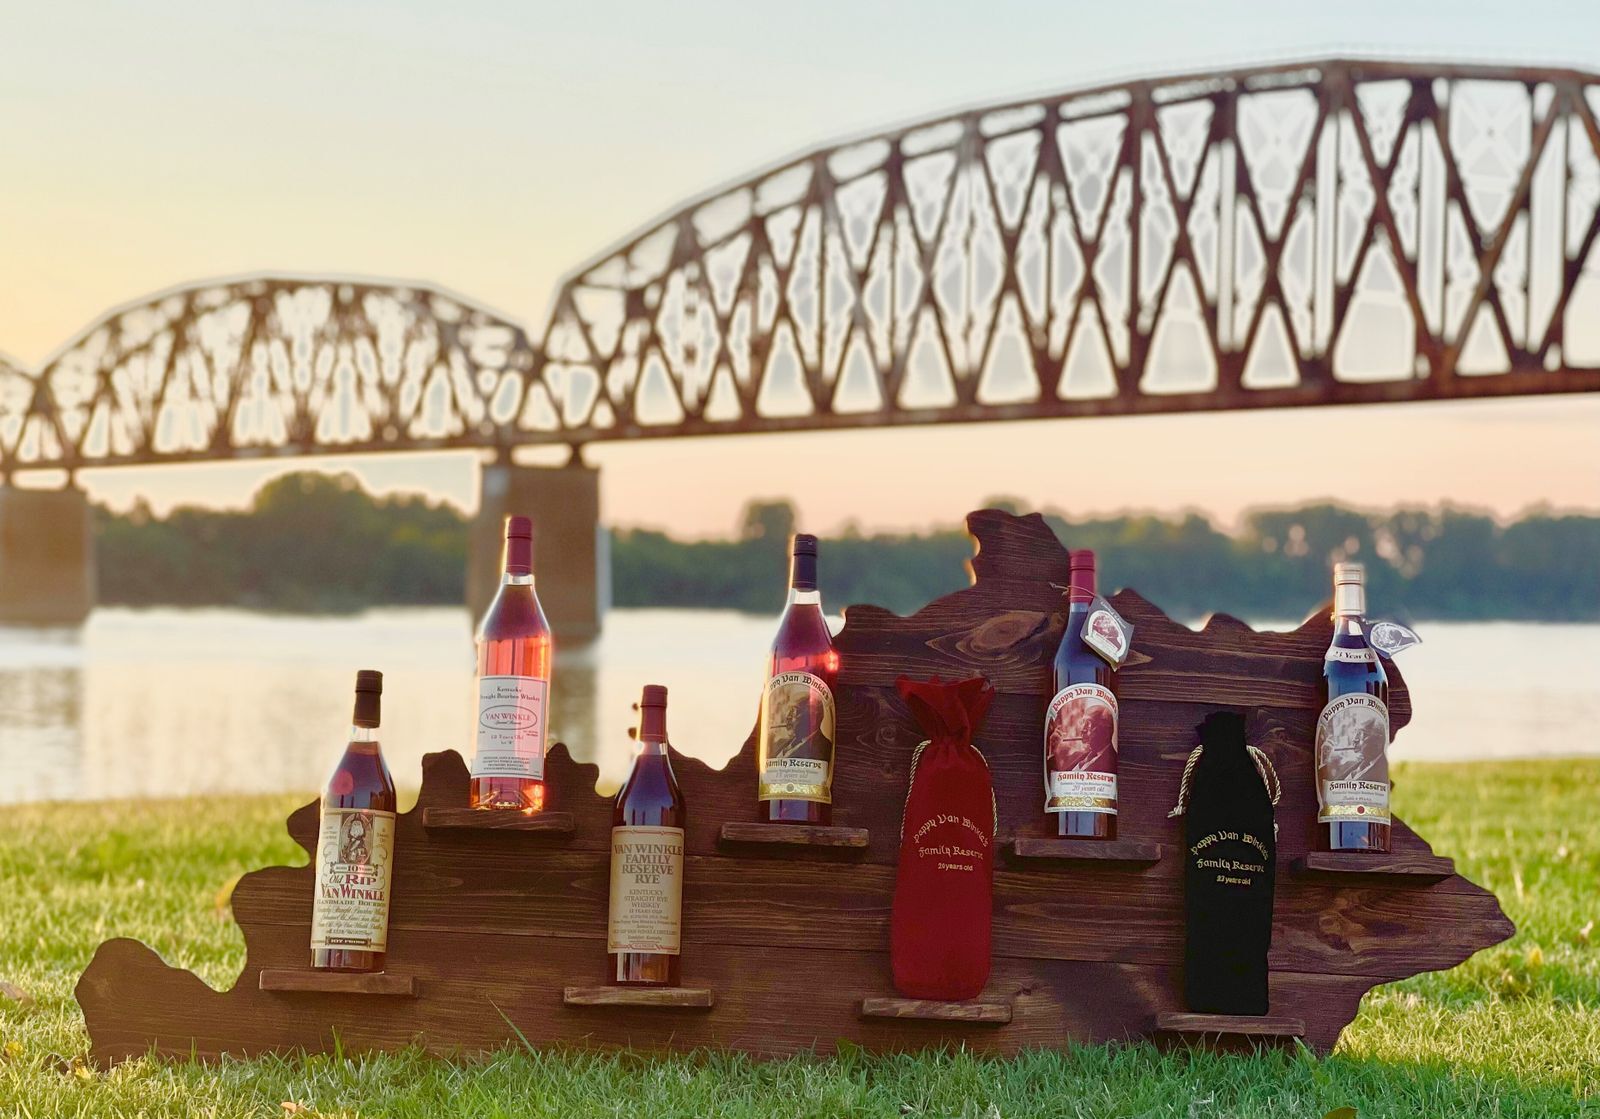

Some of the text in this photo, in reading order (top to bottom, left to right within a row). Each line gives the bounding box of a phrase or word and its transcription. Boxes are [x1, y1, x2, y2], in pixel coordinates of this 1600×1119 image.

[1344, 652, 1362, 660] Year
[782, 674, 799, 683] Van
[1053, 691, 1073, 712] Pappy
[1075, 688, 1093, 696] Van
[1322, 701, 1345, 721] Pappy
[1345, 697, 1364, 706] Van
[500, 713, 530, 721] WINKLE
[789, 759, 822, 769] Reserve
[1057, 772, 1085, 782] Family
[1329, 781, 1387, 792] Family Reserve
[913, 819, 938, 844] Pappy
[937, 813, 959, 824] Van
[1190, 833, 1219, 856] Pappy
[1217, 830, 1239, 840] Van
[614, 843, 683, 856] VAN WINKLE
[918, 844, 984, 860] Family Reserve
[625, 853, 671, 865] FAMILY
[622, 863, 674, 875] RESERVE
[1196, 858, 1265, 873] Family Reserve
[329, 873, 377, 886] Old RIP
[635, 873, 660, 884] RYE
[320, 883, 385, 901] VAN WINKLE
[629, 888, 663, 896] KENTUCKY
